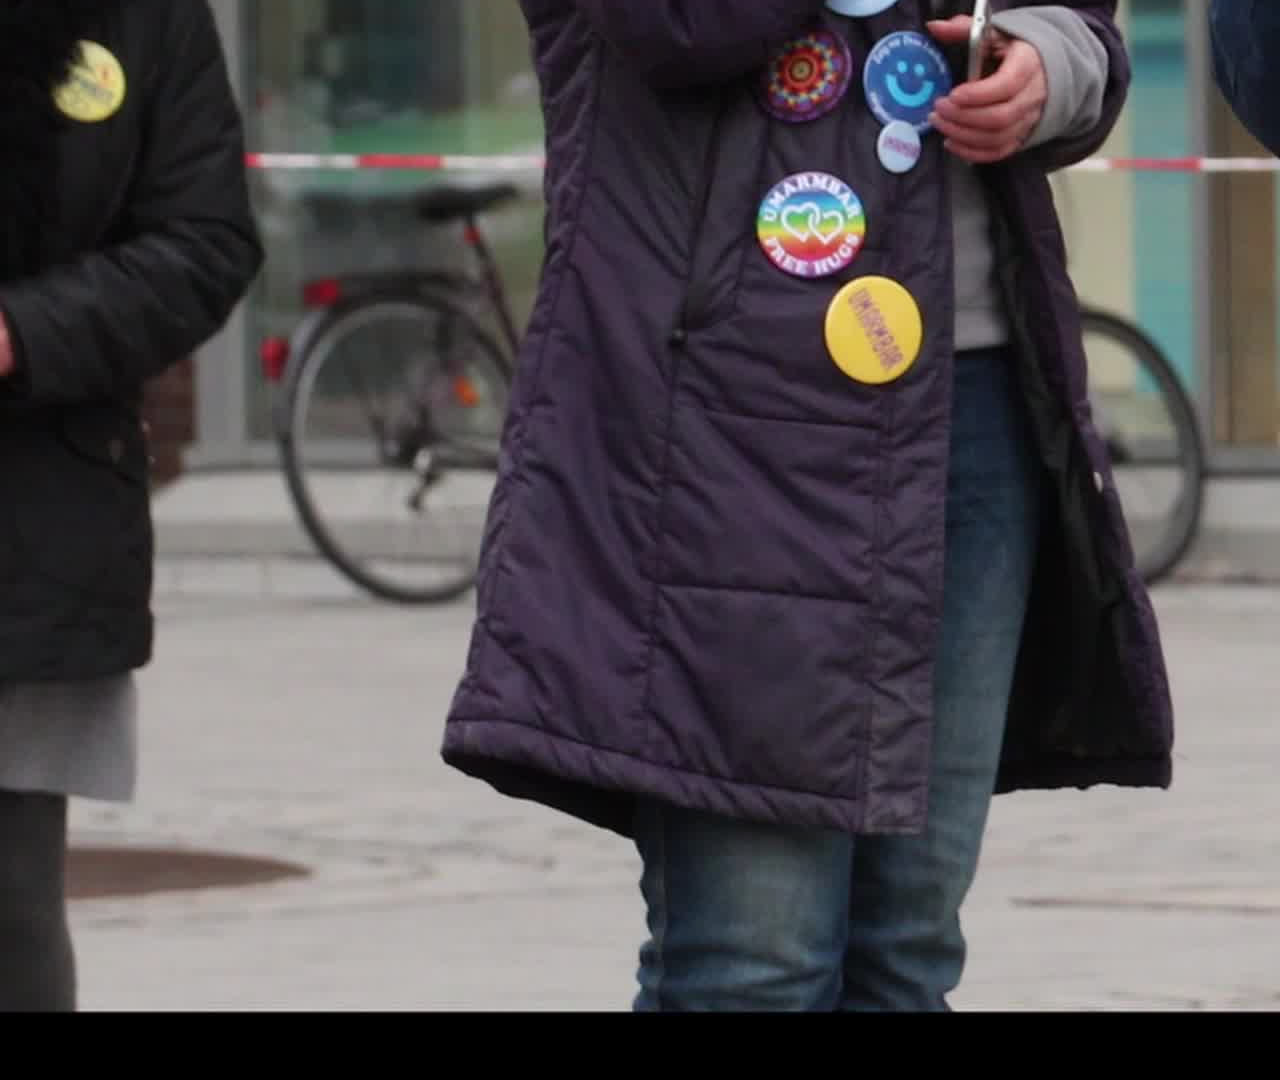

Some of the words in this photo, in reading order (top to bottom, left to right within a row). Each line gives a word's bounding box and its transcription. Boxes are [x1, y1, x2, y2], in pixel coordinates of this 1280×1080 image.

[763, 174, 863, 222] UMARMBAR
[763, 234, 809, 275] FREE
[814, 233, 861, 275] HUGS
